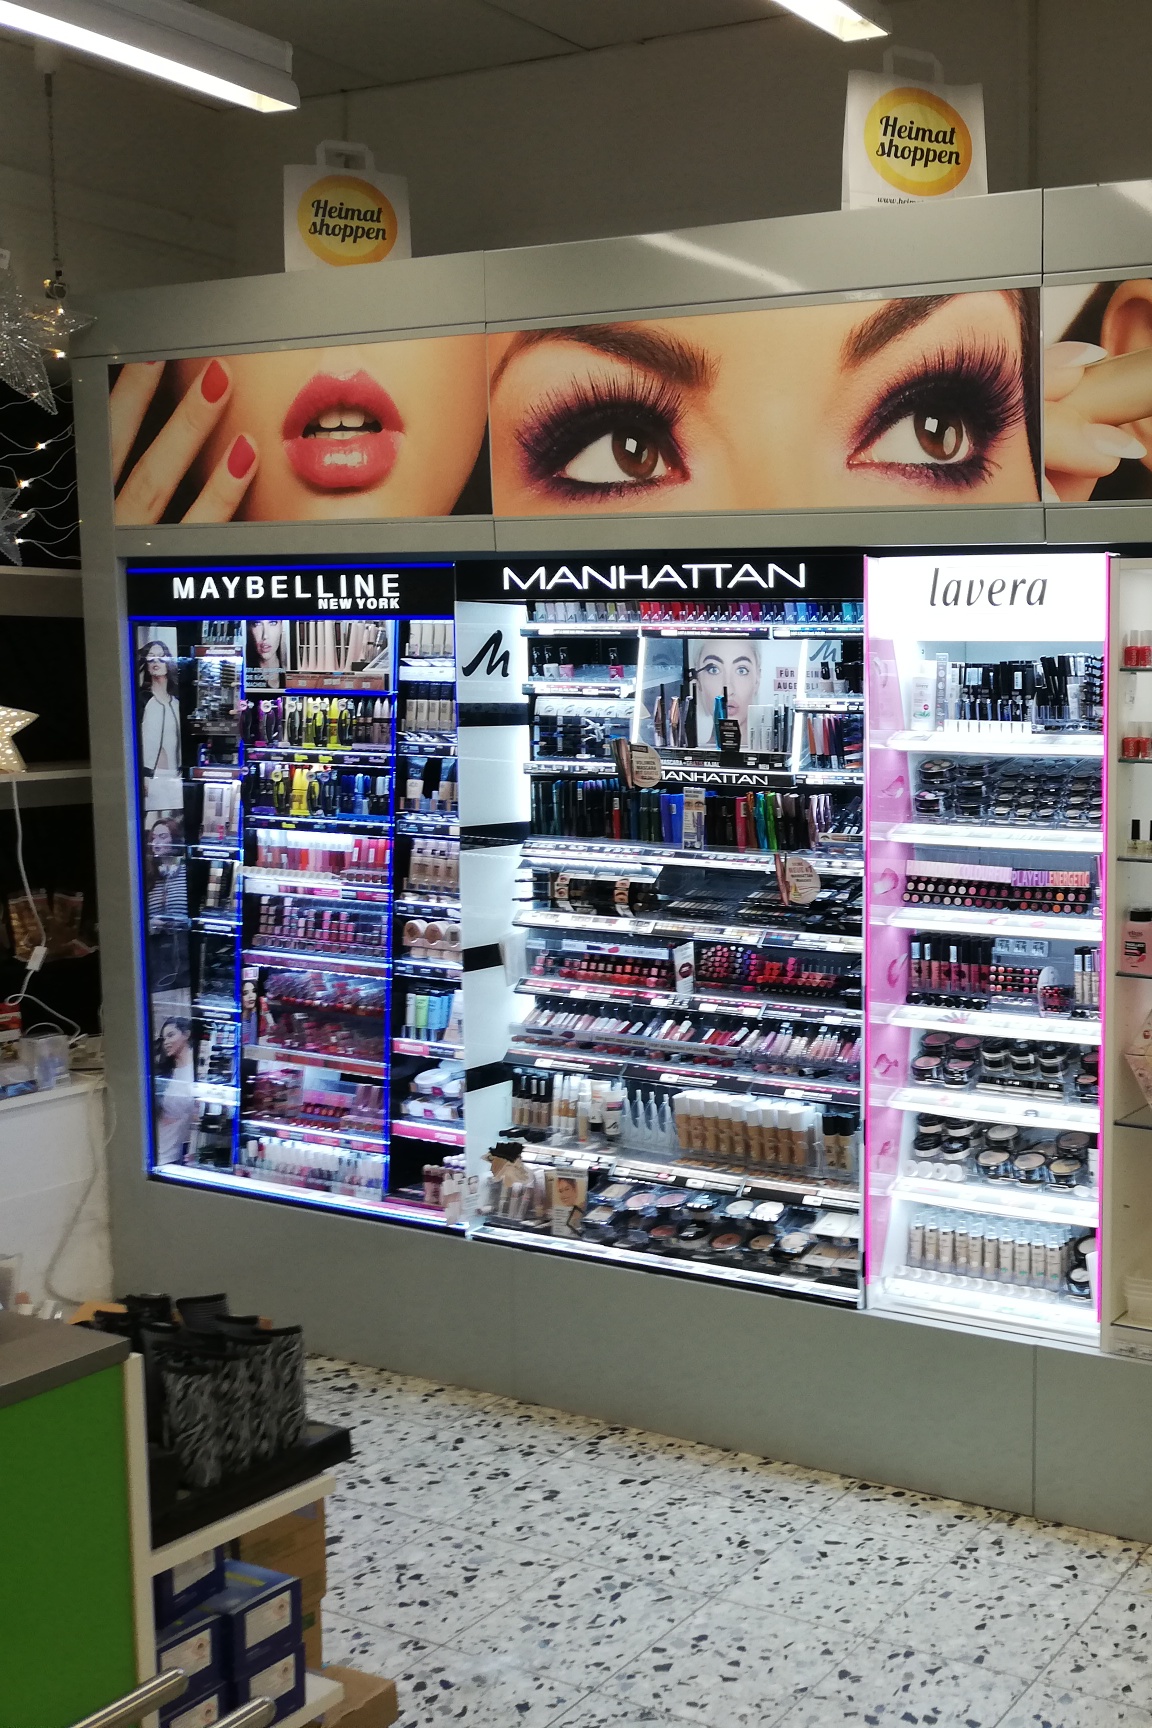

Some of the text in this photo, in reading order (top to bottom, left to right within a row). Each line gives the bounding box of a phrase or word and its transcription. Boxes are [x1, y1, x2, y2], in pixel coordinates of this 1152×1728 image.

[879, 115, 957, 146] Heimat
[875, 139, 962, 168] shoppen
[311, 199, 383, 224] Heimat
[308, 219, 387, 244] shoppen
[172, 573, 400, 600] MAYBELLINE
[503, 563, 806, 591] MANHATTAN
[930, 567, 1048, 607] lavera
[317, 597, 401, 611] NEW YORK
[779, 668, 795, 678] FÜR
[1012, 871, 1050, 887] PLAYFUL
[1050, 872, 1090, 887] ENERGETIC
